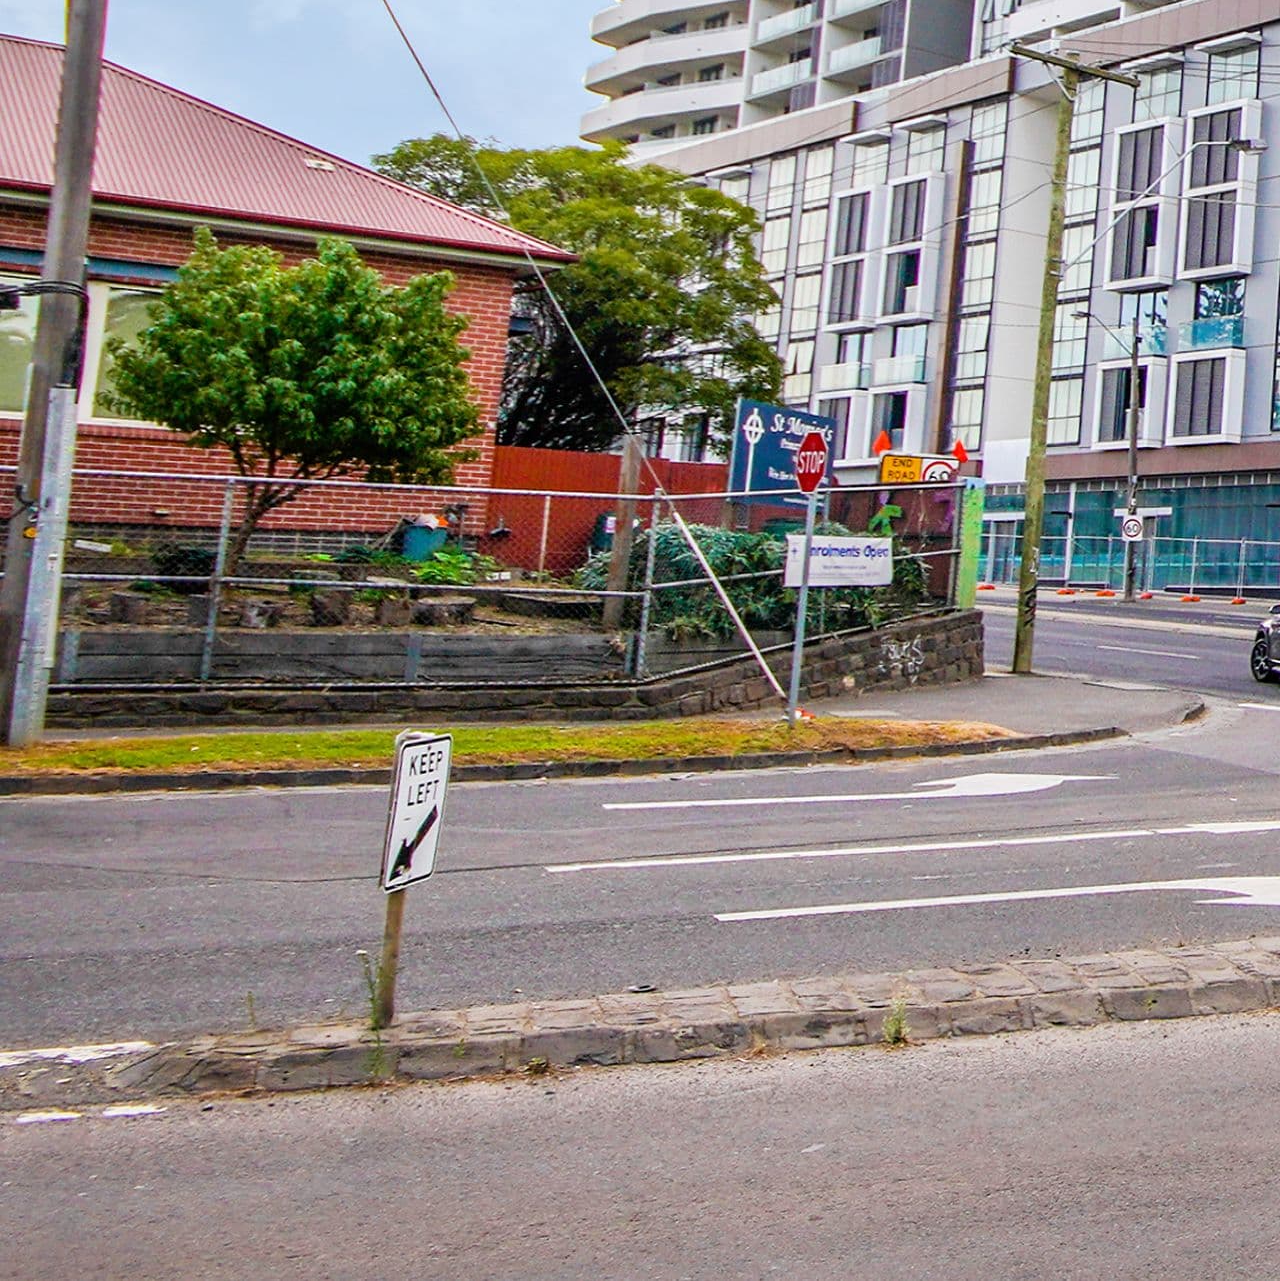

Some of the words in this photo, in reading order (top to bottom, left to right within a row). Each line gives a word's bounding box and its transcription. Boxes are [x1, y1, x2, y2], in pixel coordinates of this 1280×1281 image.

[770, 413, 785, 432] St
[798, 451, 825, 474] STOP
[893, 459, 912, 468] END
[888, 470, 916, 480] ROAD
[1126, 523, 1138, 533] 60
[809, 544, 861, 558] nrolments
[409, 750, 443, 777] KEEP
[407, 779, 440, 807] LEFT
